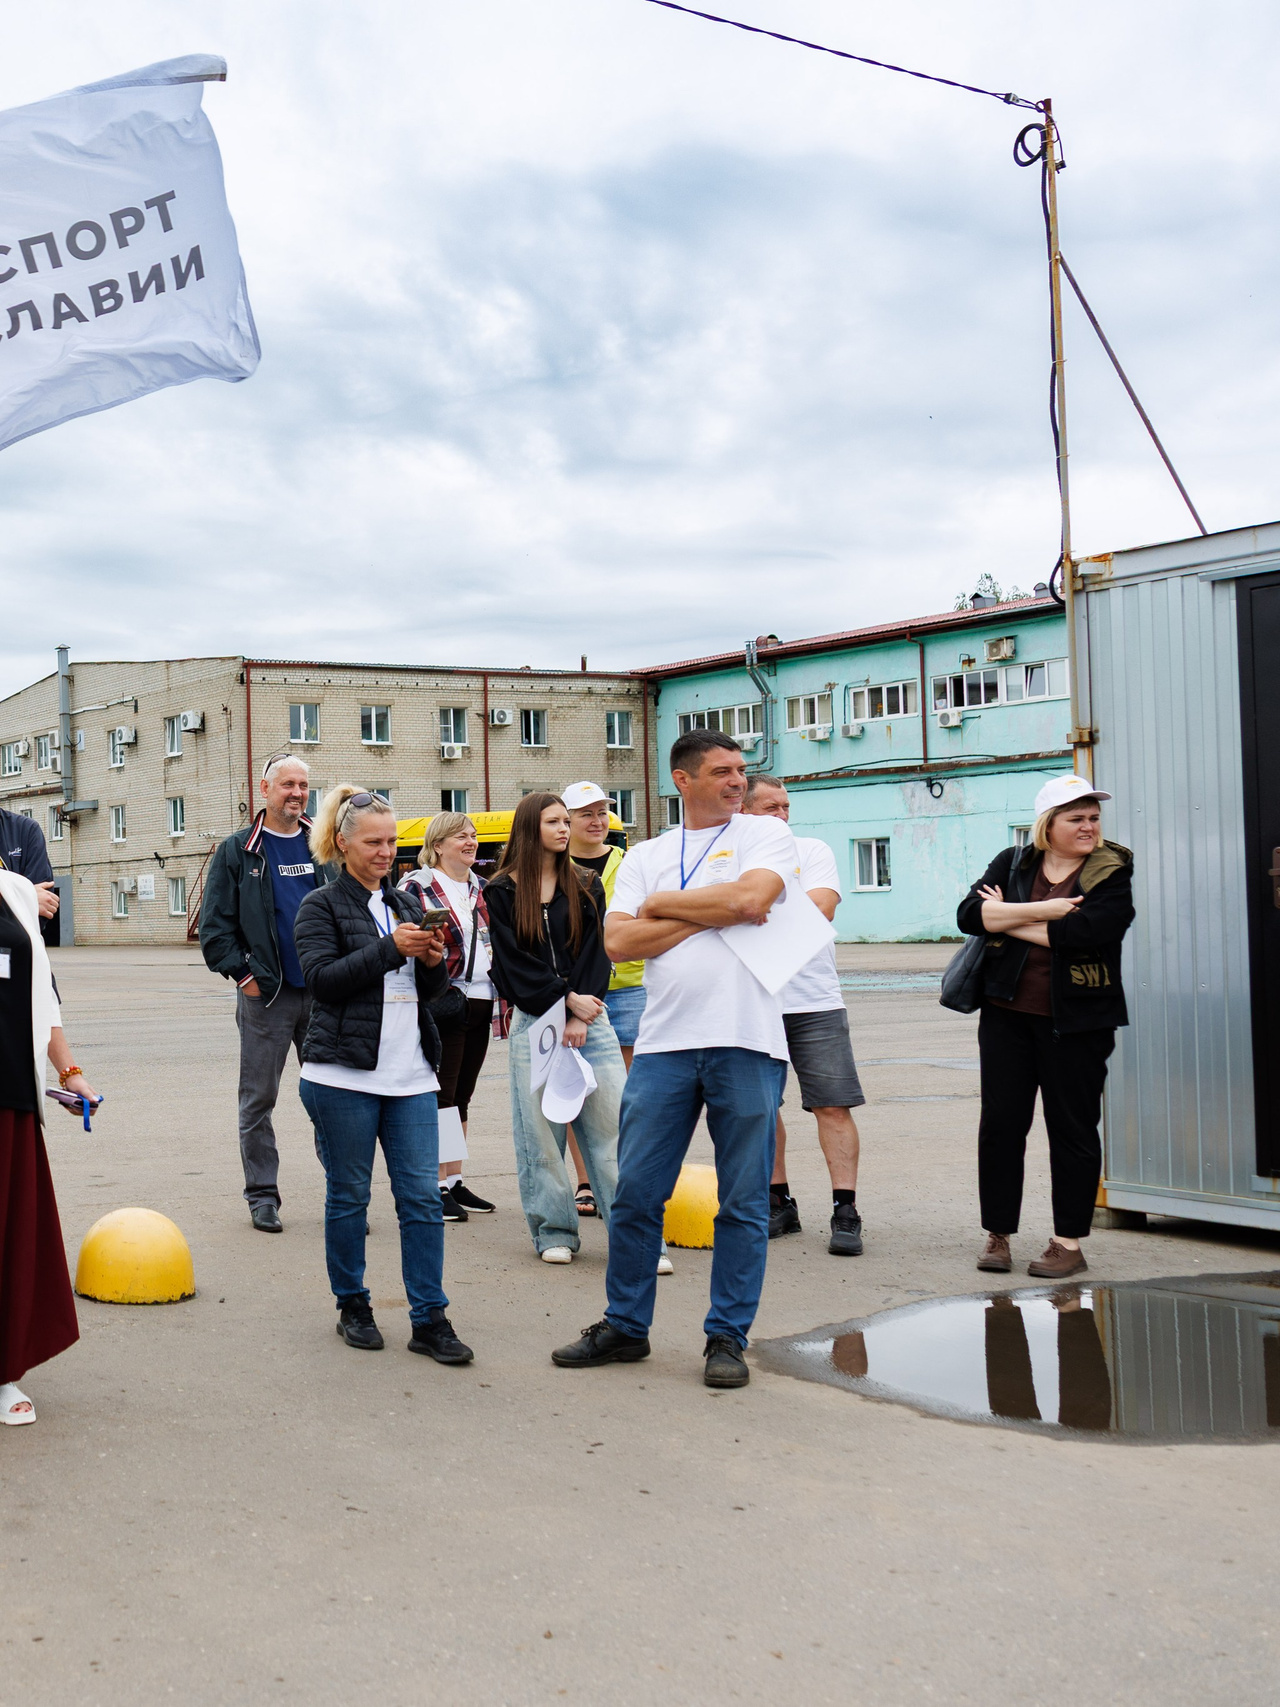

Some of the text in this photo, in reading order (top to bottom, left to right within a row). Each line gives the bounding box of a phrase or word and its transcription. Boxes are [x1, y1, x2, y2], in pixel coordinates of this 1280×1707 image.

[470, 815, 502, 825] ЕТАН
[280, 865, 306, 876] PUMA
[538, 1024, 558, 1073] 9
